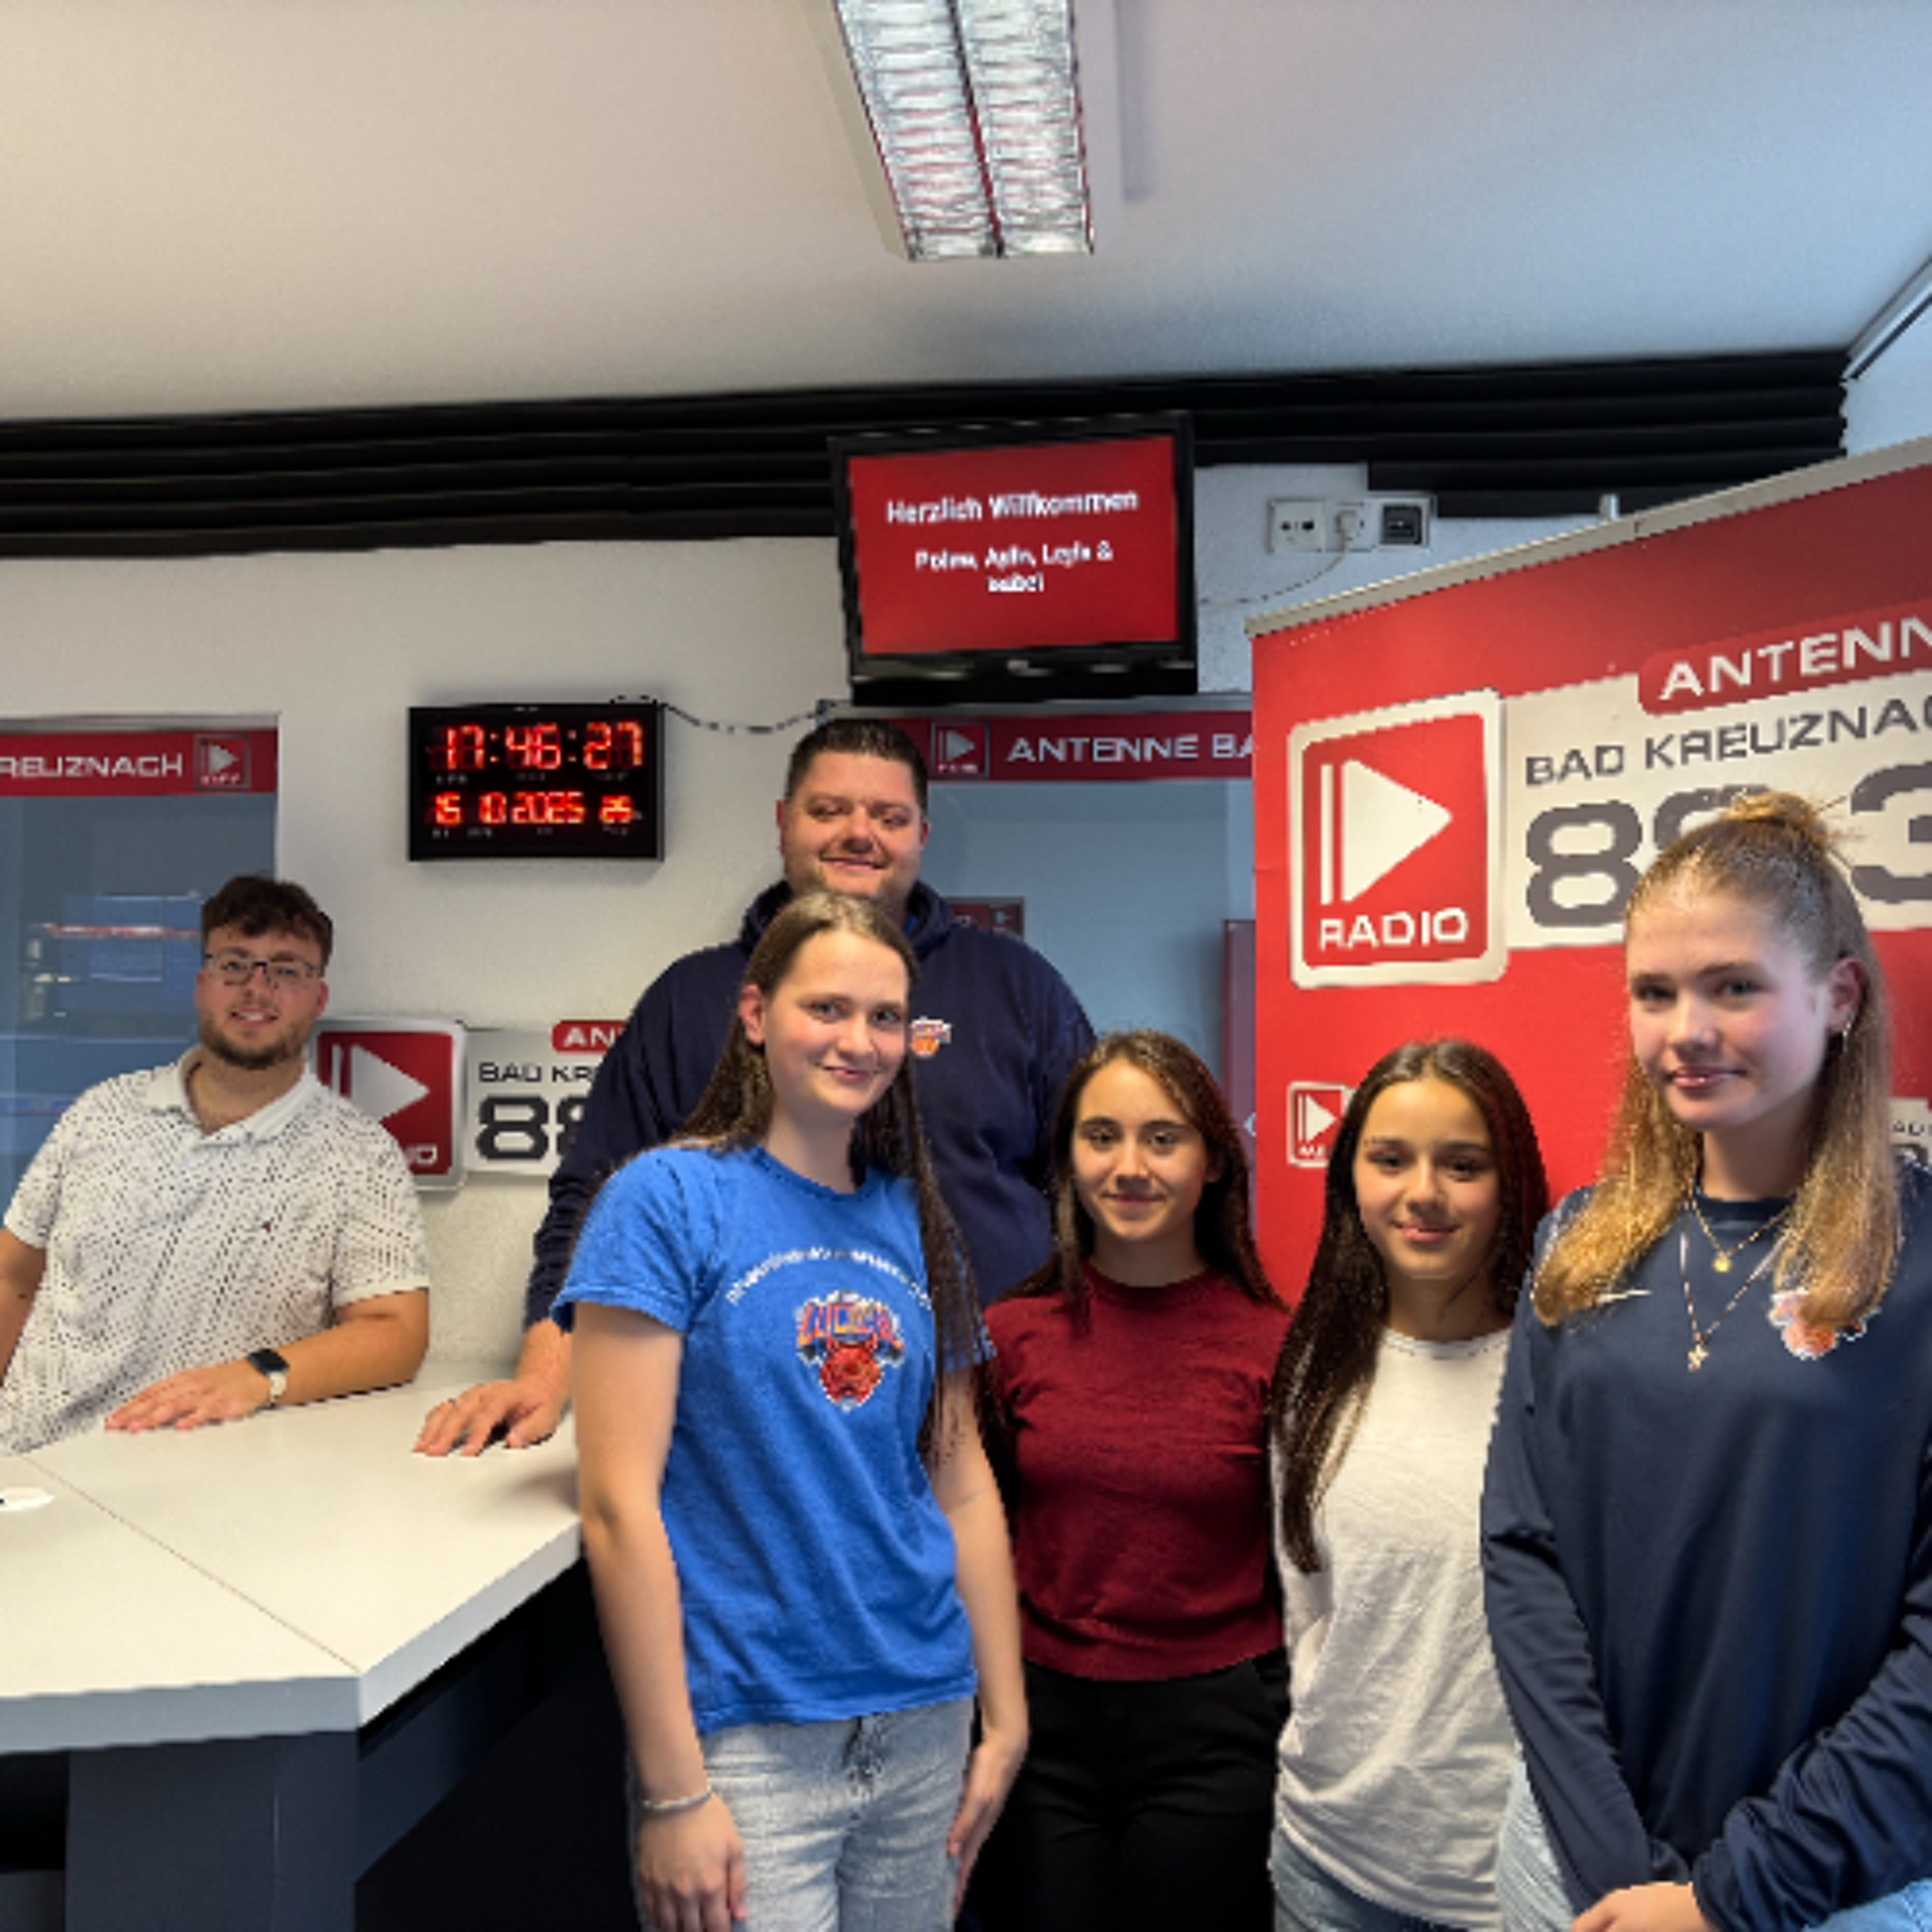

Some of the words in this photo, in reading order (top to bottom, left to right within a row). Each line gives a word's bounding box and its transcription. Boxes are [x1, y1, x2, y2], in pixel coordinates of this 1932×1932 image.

[887, 496, 983, 524] Herzlich
[989, 489, 1139, 519] Willkommen
[1096, 540, 1113, 562] &
[444, 720, 643, 770] 17:46:27
[1006, 734, 1198, 762] ANTENNE
[1526, 745, 1625, 787] BAD
[1645, 692, 1932, 770] KREUZNA
[1319, 907, 1469, 952] RADIO
[478, 1063, 542, 1083] BAD
